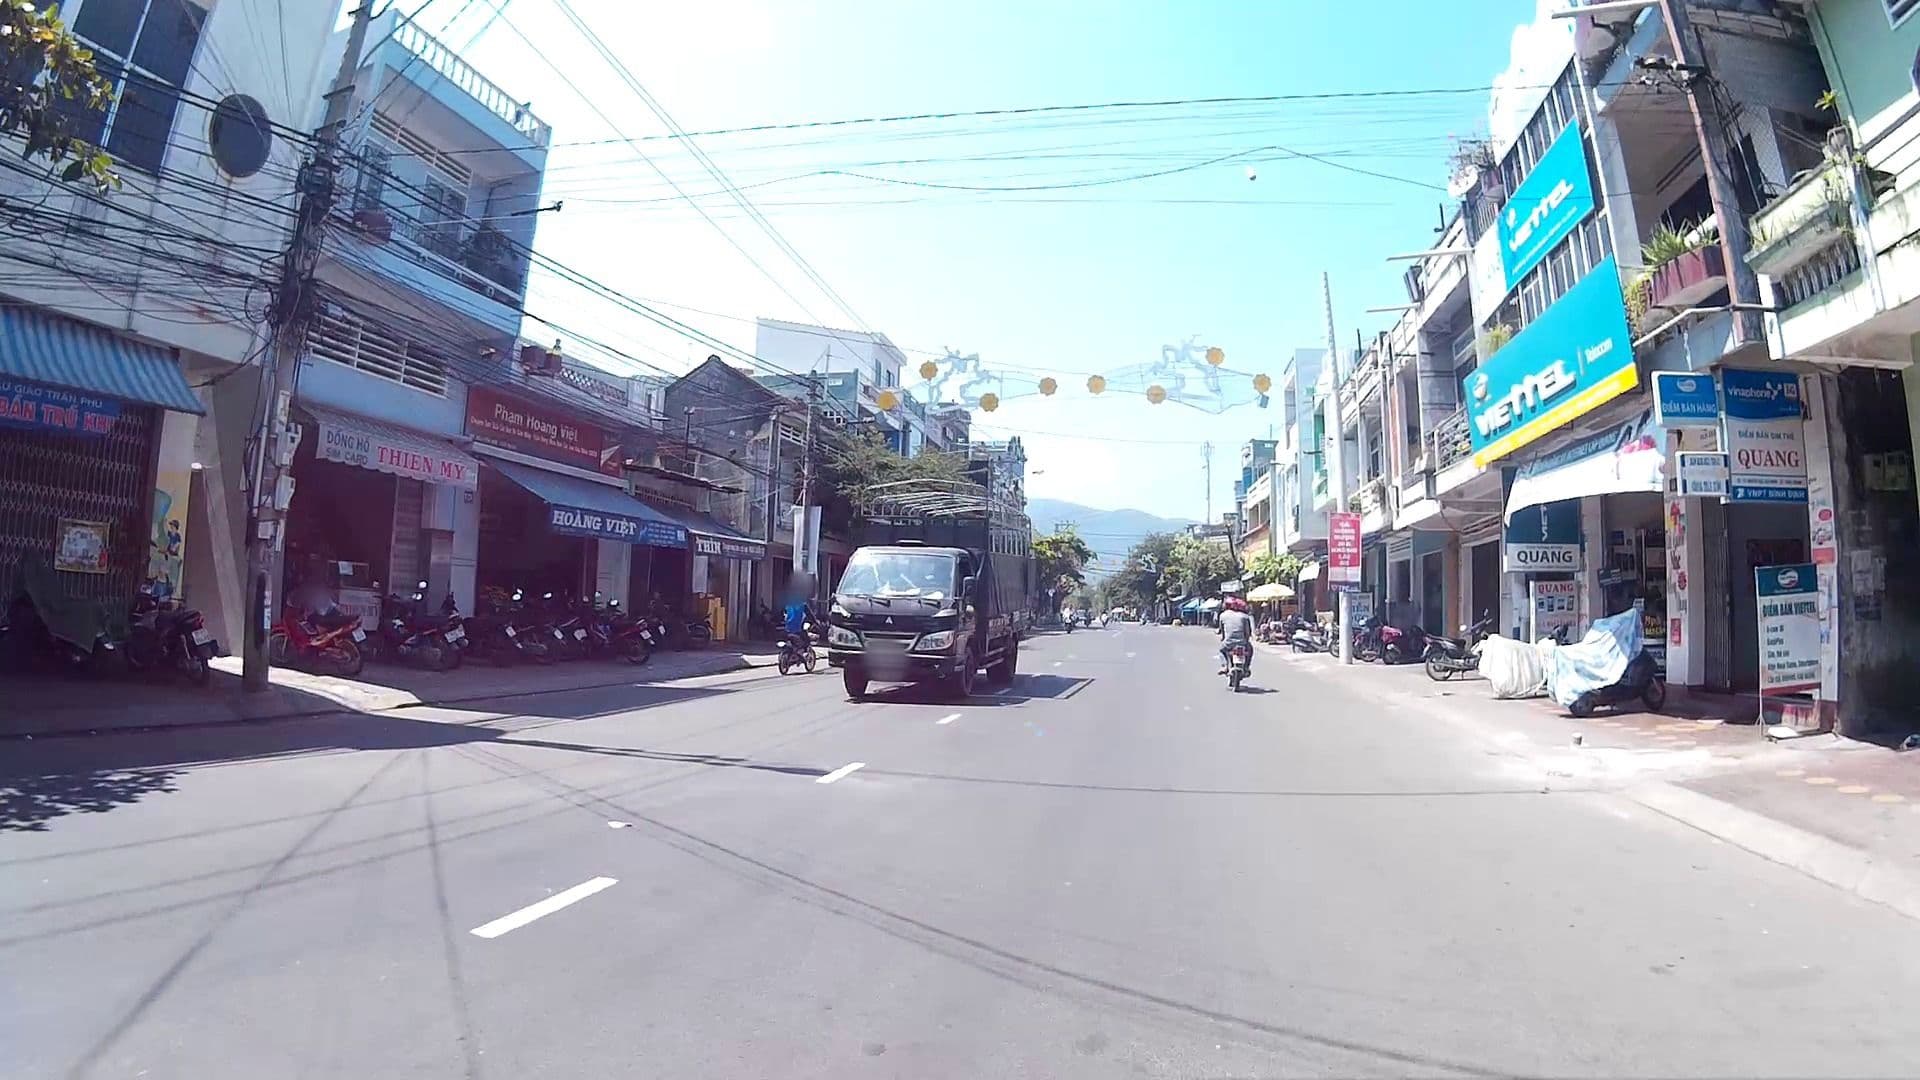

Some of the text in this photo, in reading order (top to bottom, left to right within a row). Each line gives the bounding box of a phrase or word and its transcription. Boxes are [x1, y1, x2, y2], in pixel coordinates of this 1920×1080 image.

[1509, 178, 1574, 252] VIETTEL
[1475, 360, 1577, 438] VIETTEL
[1738, 449, 1799, 469] QUANG
[552, 508, 602, 531] HOÀNG
[606, 517, 637, 537] VIỆT
[1517, 550, 1573, 564] QUANG
[1538, 583, 1574, 595] QUANG
